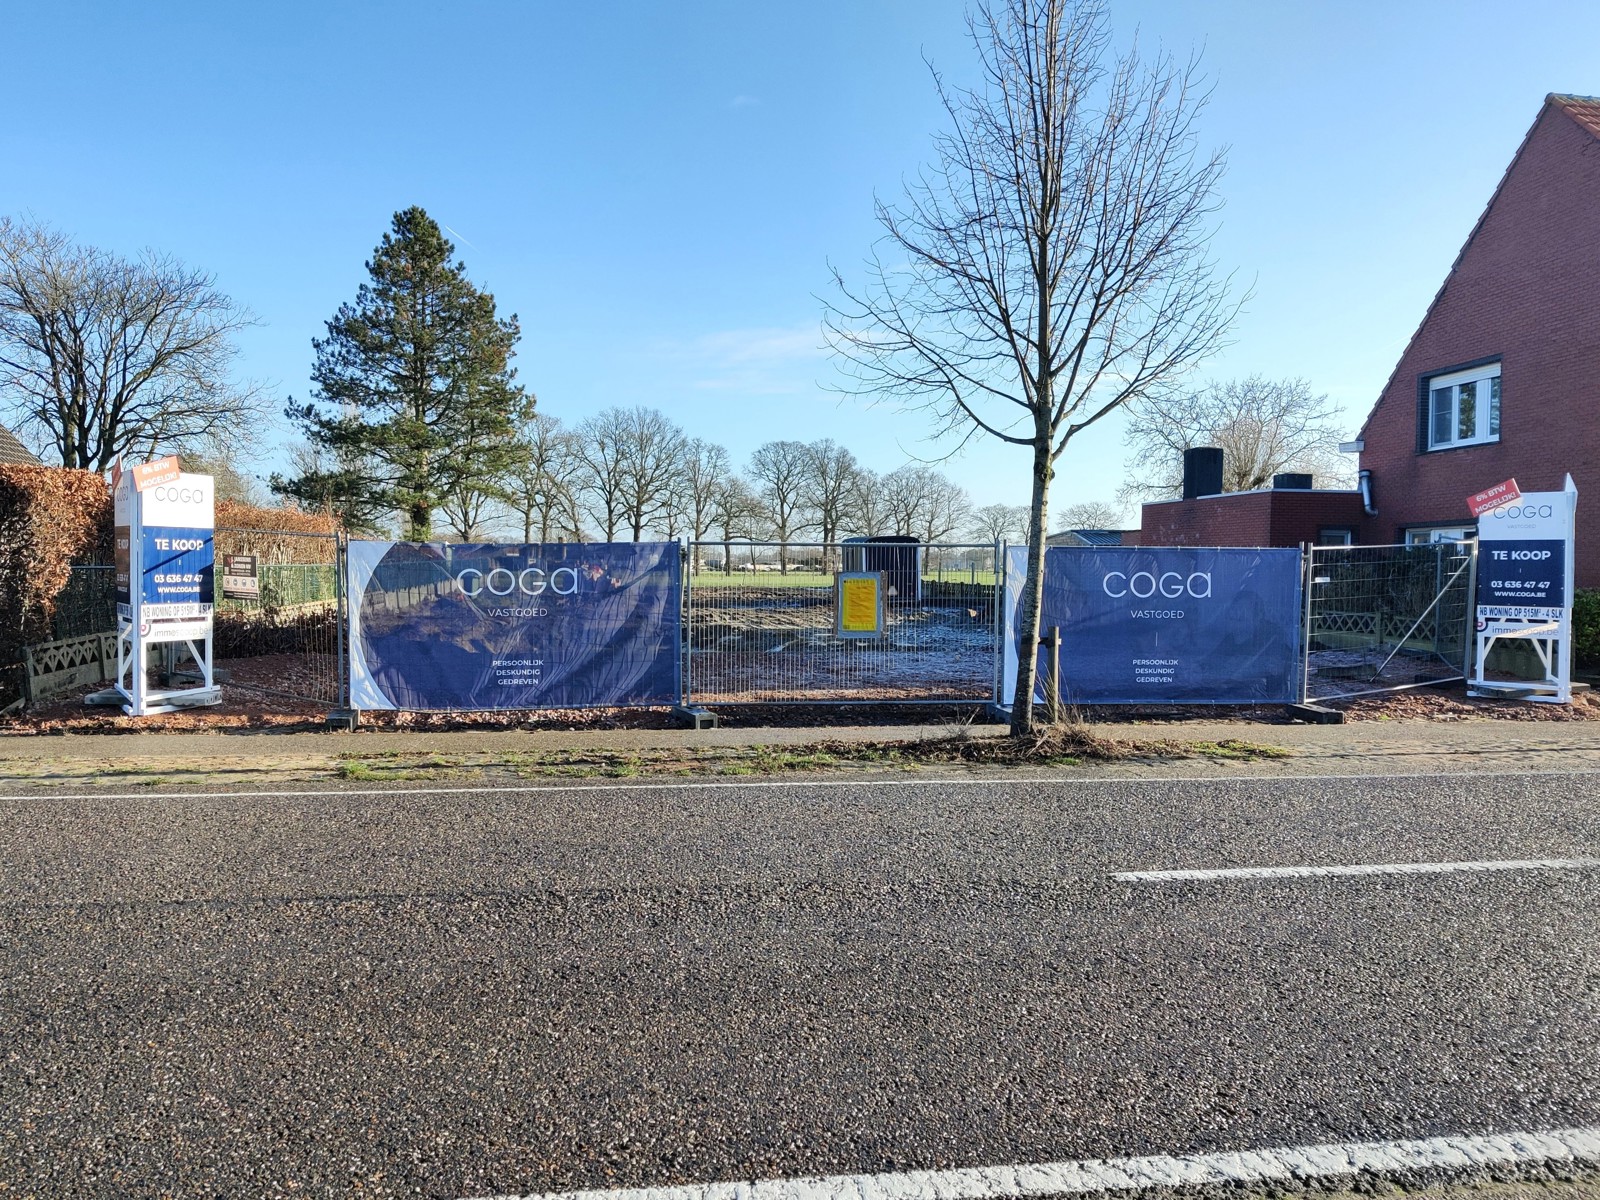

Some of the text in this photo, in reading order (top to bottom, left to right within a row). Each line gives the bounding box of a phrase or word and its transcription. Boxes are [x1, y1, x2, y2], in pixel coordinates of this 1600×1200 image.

[154, 461, 170, 471] BTW
[1476, 484, 1507, 502] 6% BTW
[1475, 491, 1517, 514] MOGELIJK!
[155, 539, 204, 551] TE KOOP
[1491, 550, 1551, 560] TE KOOP
[154, 574, 203, 583] 03 636 47 47
[1491, 580, 1551, 589] 03 636 47 47
[488, 608, 548, 617] VASTGOED
[1130, 610, 1185, 619] VASTGOED
[1480, 607, 1488, 616] NB
[1489, 607, 1513, 617] WONING
[1514, 608, 1523, 617] OP
[1545, 609, 1550, 618] 4
[1551, 609, 1564, 618] SLK
[492, 659, 545, 667] PERSOONLIJK
